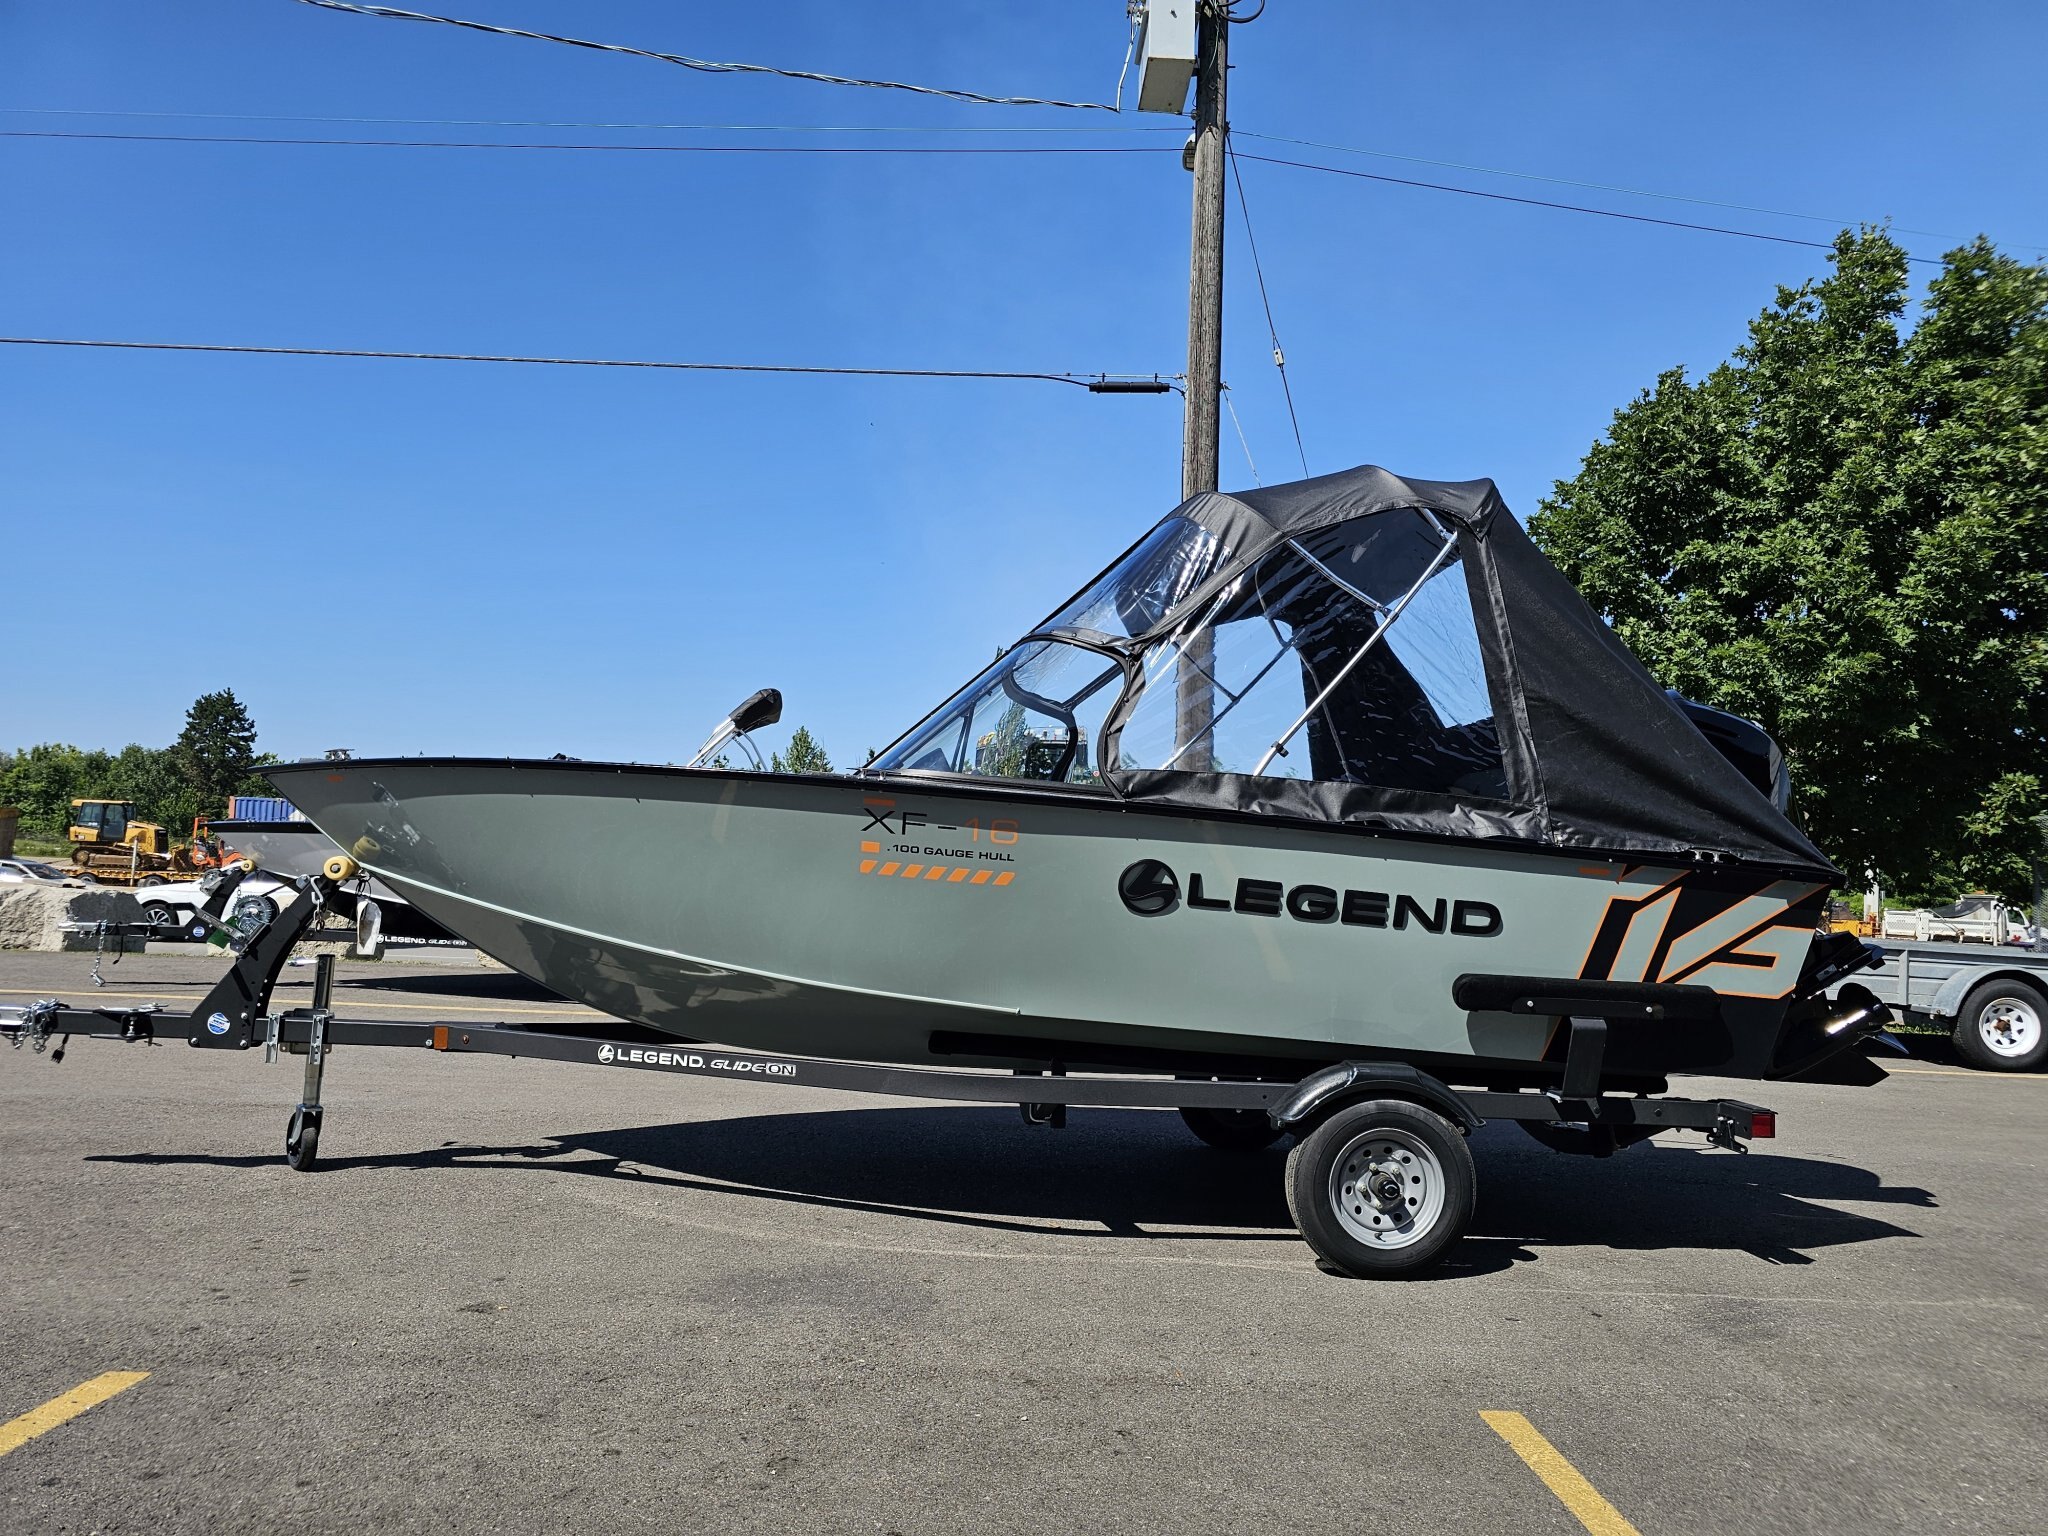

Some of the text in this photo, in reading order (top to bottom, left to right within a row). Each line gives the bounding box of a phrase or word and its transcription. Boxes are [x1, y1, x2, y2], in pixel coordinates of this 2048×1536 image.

[860, 807, 1019, 844] XF-16
[923, 846, 974, 859] GAUGE
[978, 851, 1015, 862] HULL
[1187, 872, 1502, 937] LEGEND
